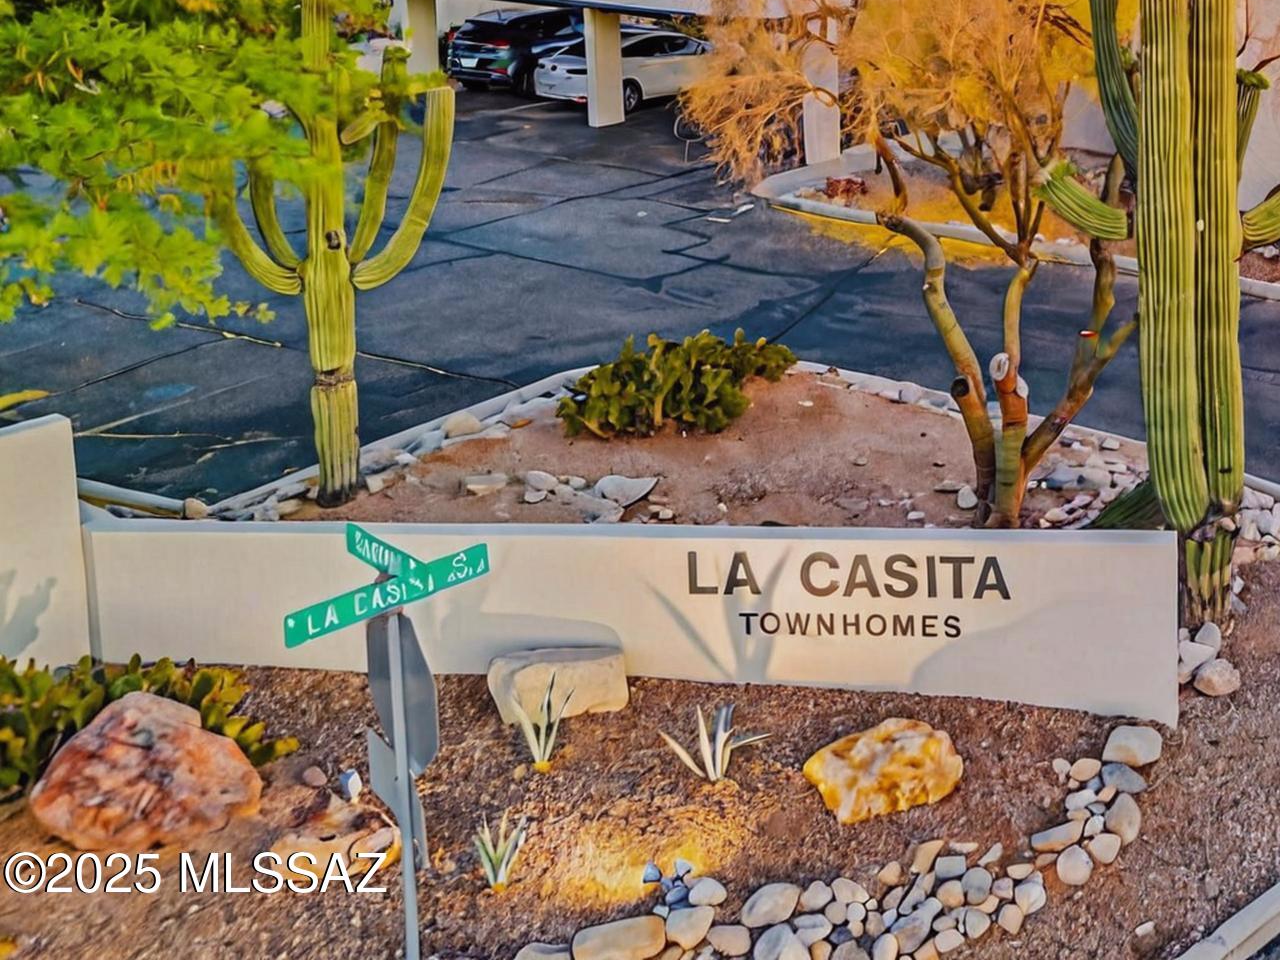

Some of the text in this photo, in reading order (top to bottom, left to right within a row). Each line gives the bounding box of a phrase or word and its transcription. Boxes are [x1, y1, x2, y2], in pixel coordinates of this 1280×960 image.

[687, 551, 1011, 600] LA CASITA
[307, 603, 339, 635] LA
[739, 612, 961, 638] TOWNHOMES
